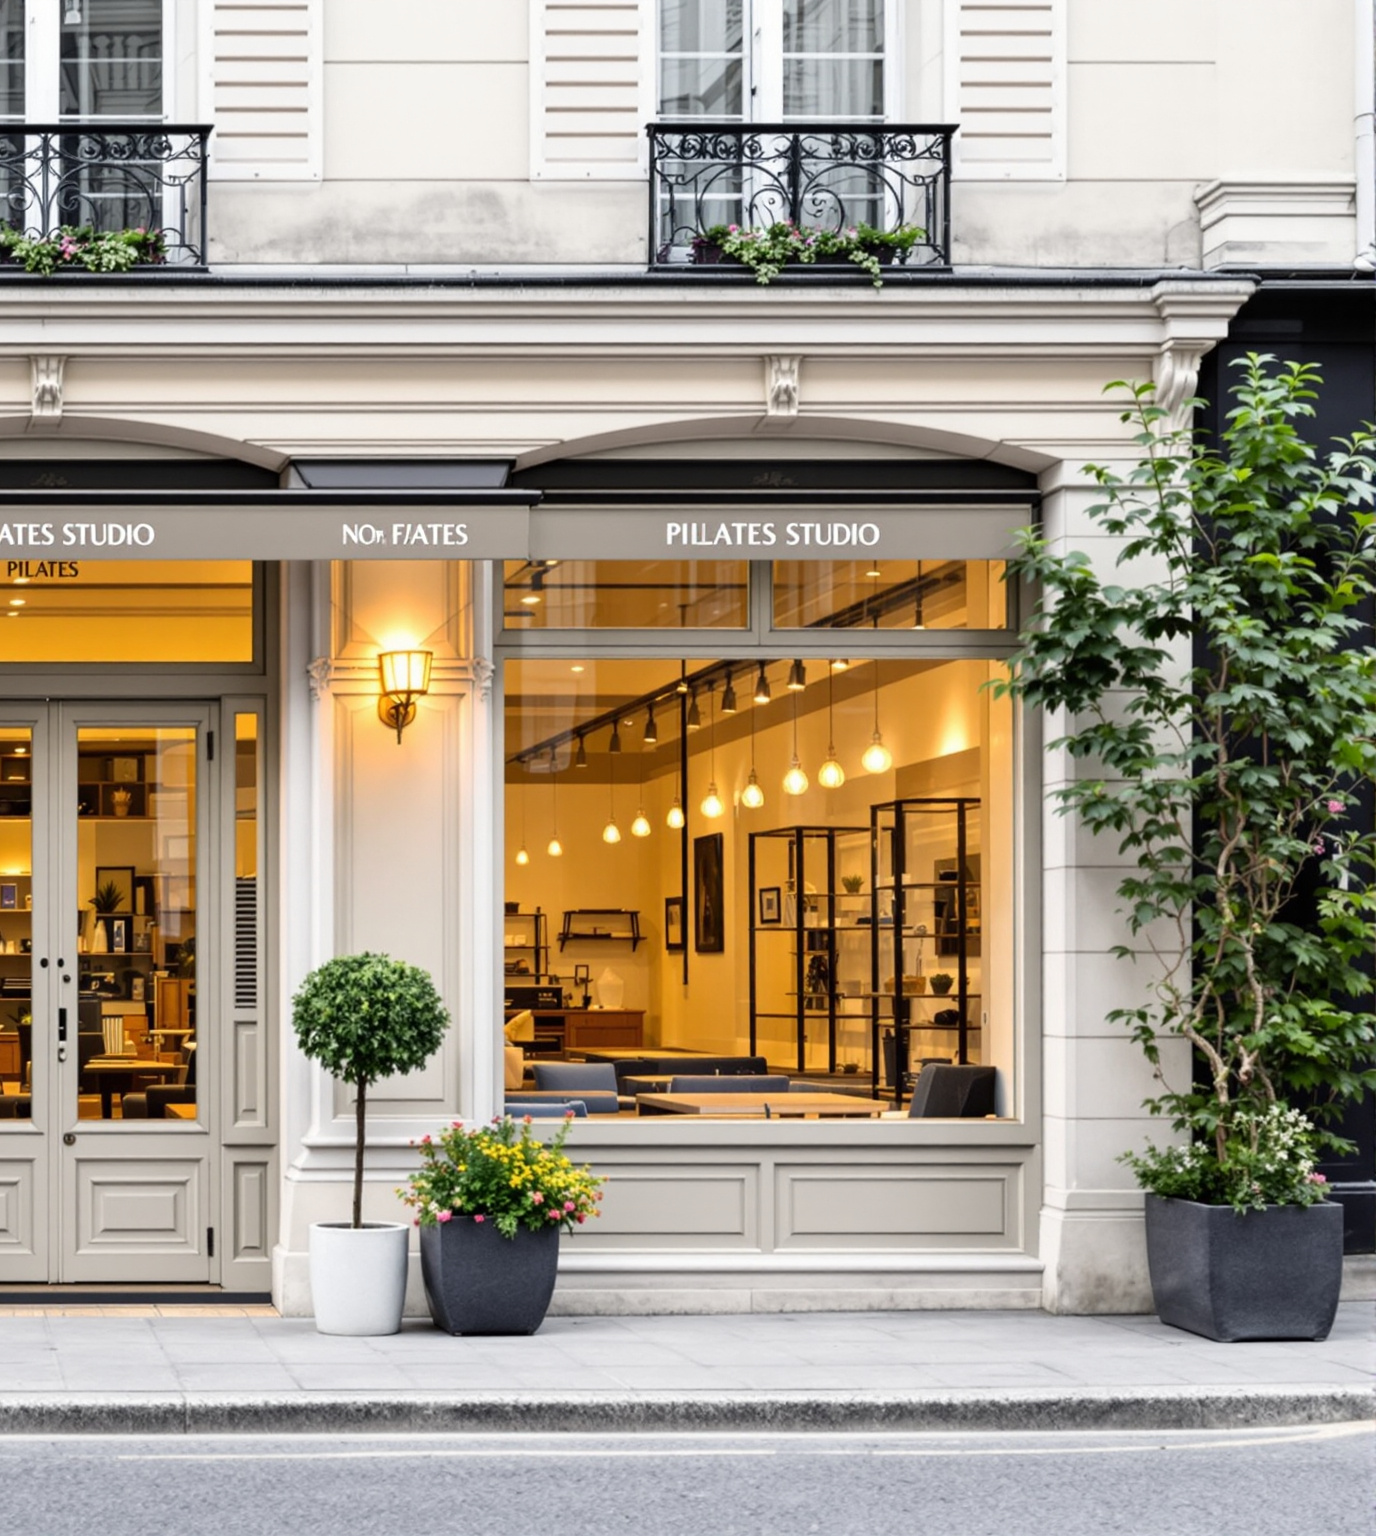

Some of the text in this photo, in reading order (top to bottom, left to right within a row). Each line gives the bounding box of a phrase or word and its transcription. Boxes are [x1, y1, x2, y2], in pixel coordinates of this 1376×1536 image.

[62, 522, 155, 546] STUDIO
[786, 522, 880, 546] STUDIO
[7, 560, 79, 578] PILATES
